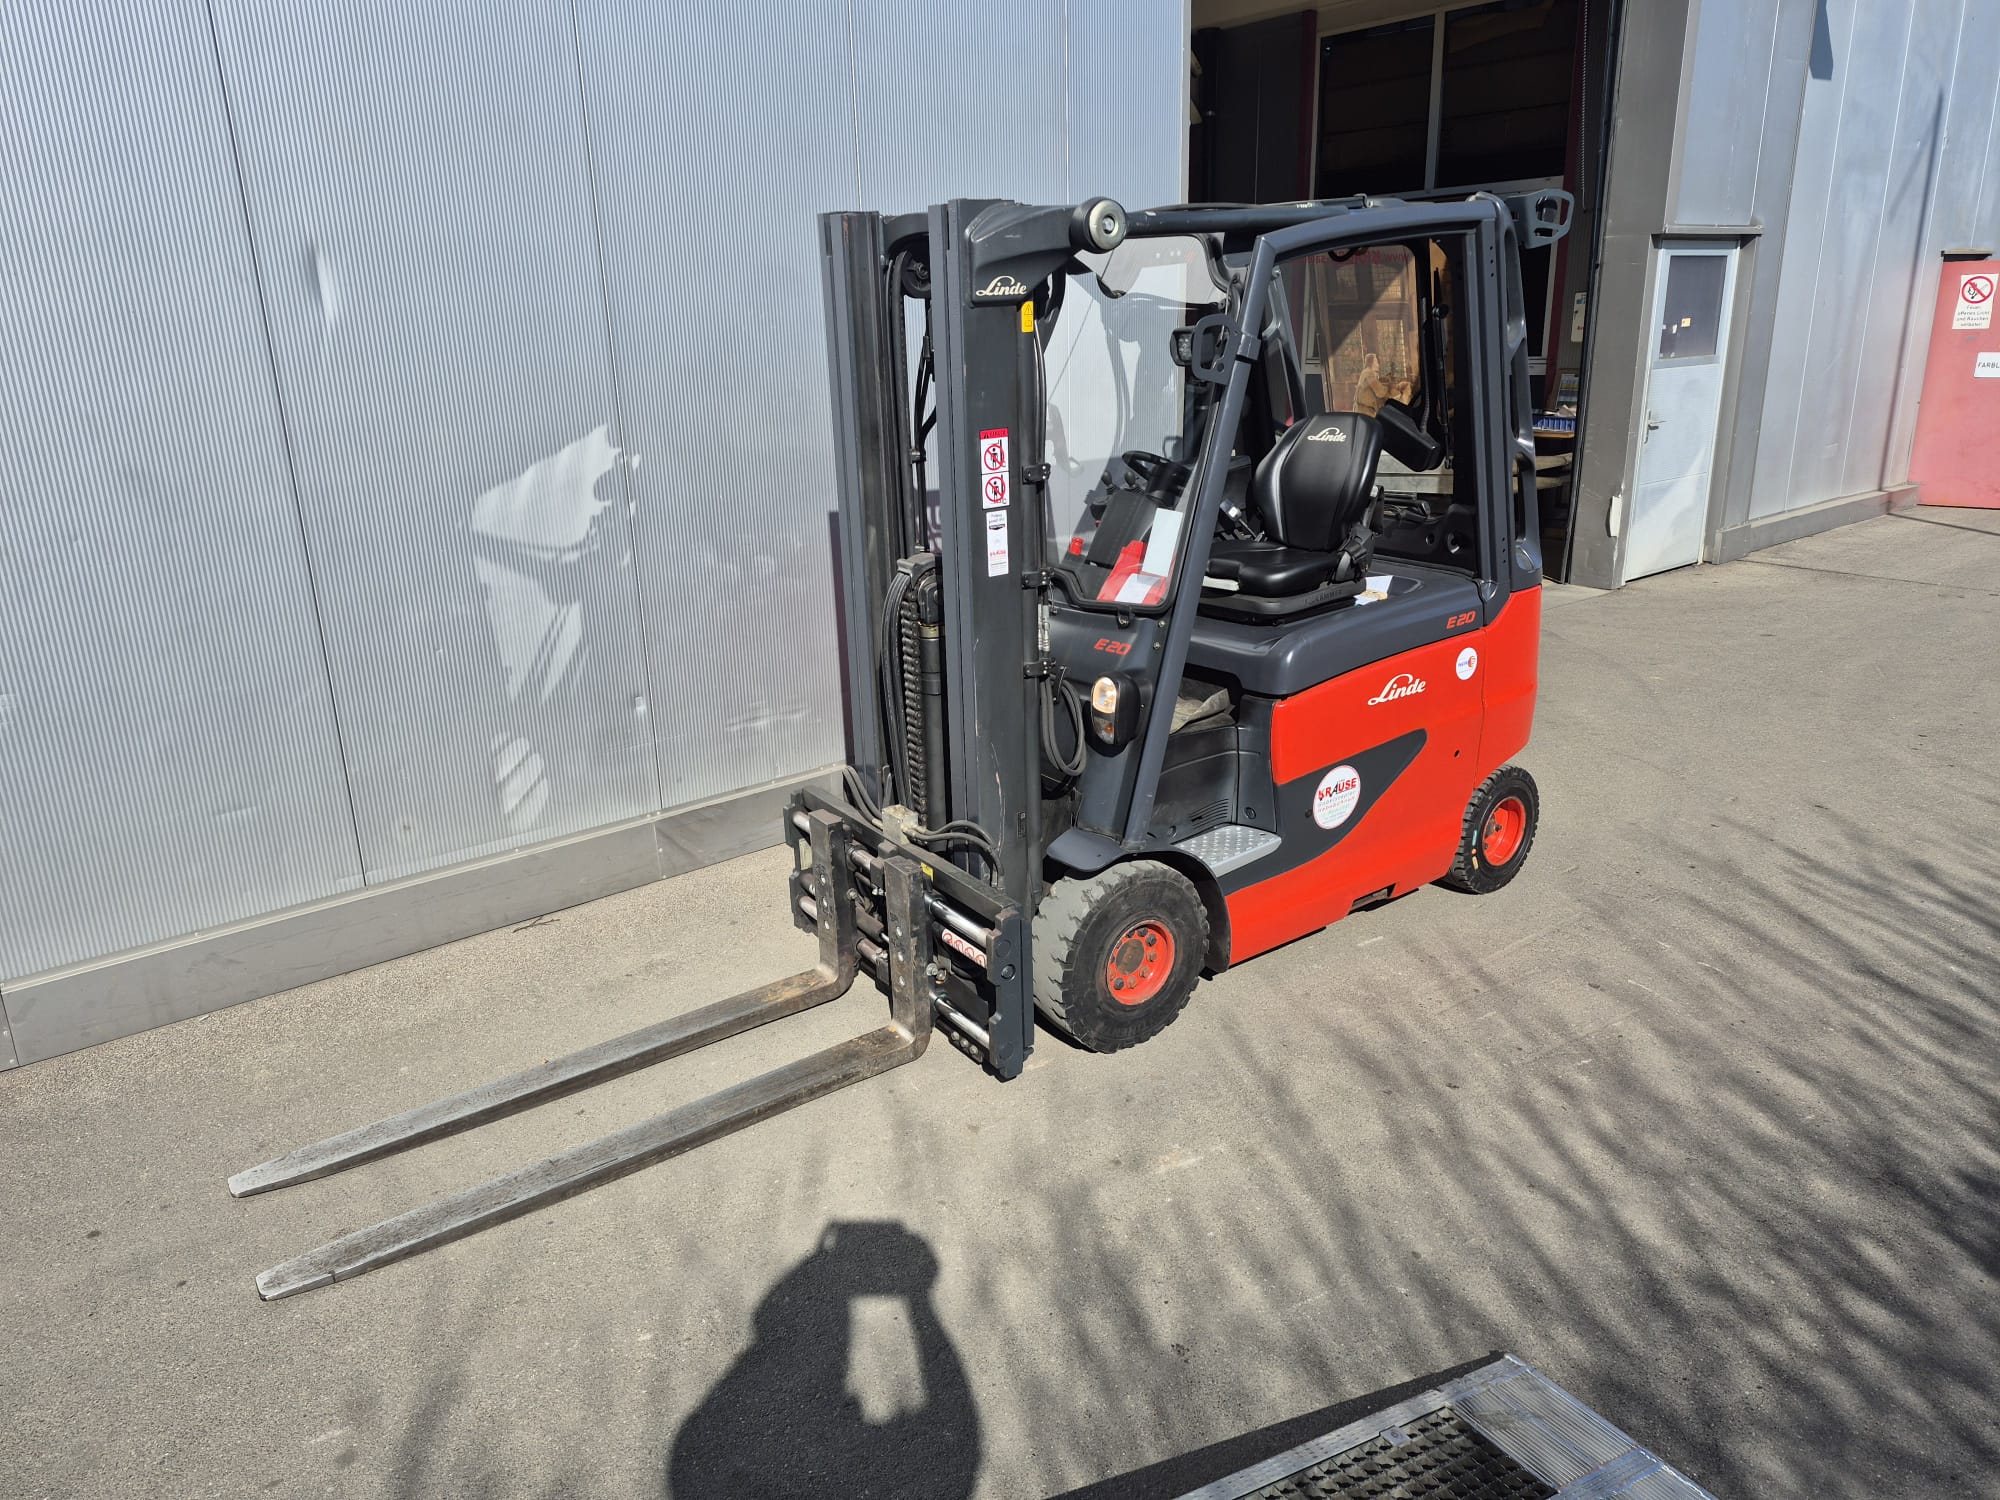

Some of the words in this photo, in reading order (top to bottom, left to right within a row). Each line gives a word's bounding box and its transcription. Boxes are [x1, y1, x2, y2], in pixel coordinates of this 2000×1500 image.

[975, 275, 1028, 297] Linde
[1307, 426, 1347, 442] Linde
[1367, 673, 1427, 706] Linde
[1318, 777, 1358, 802] KRAUSE
